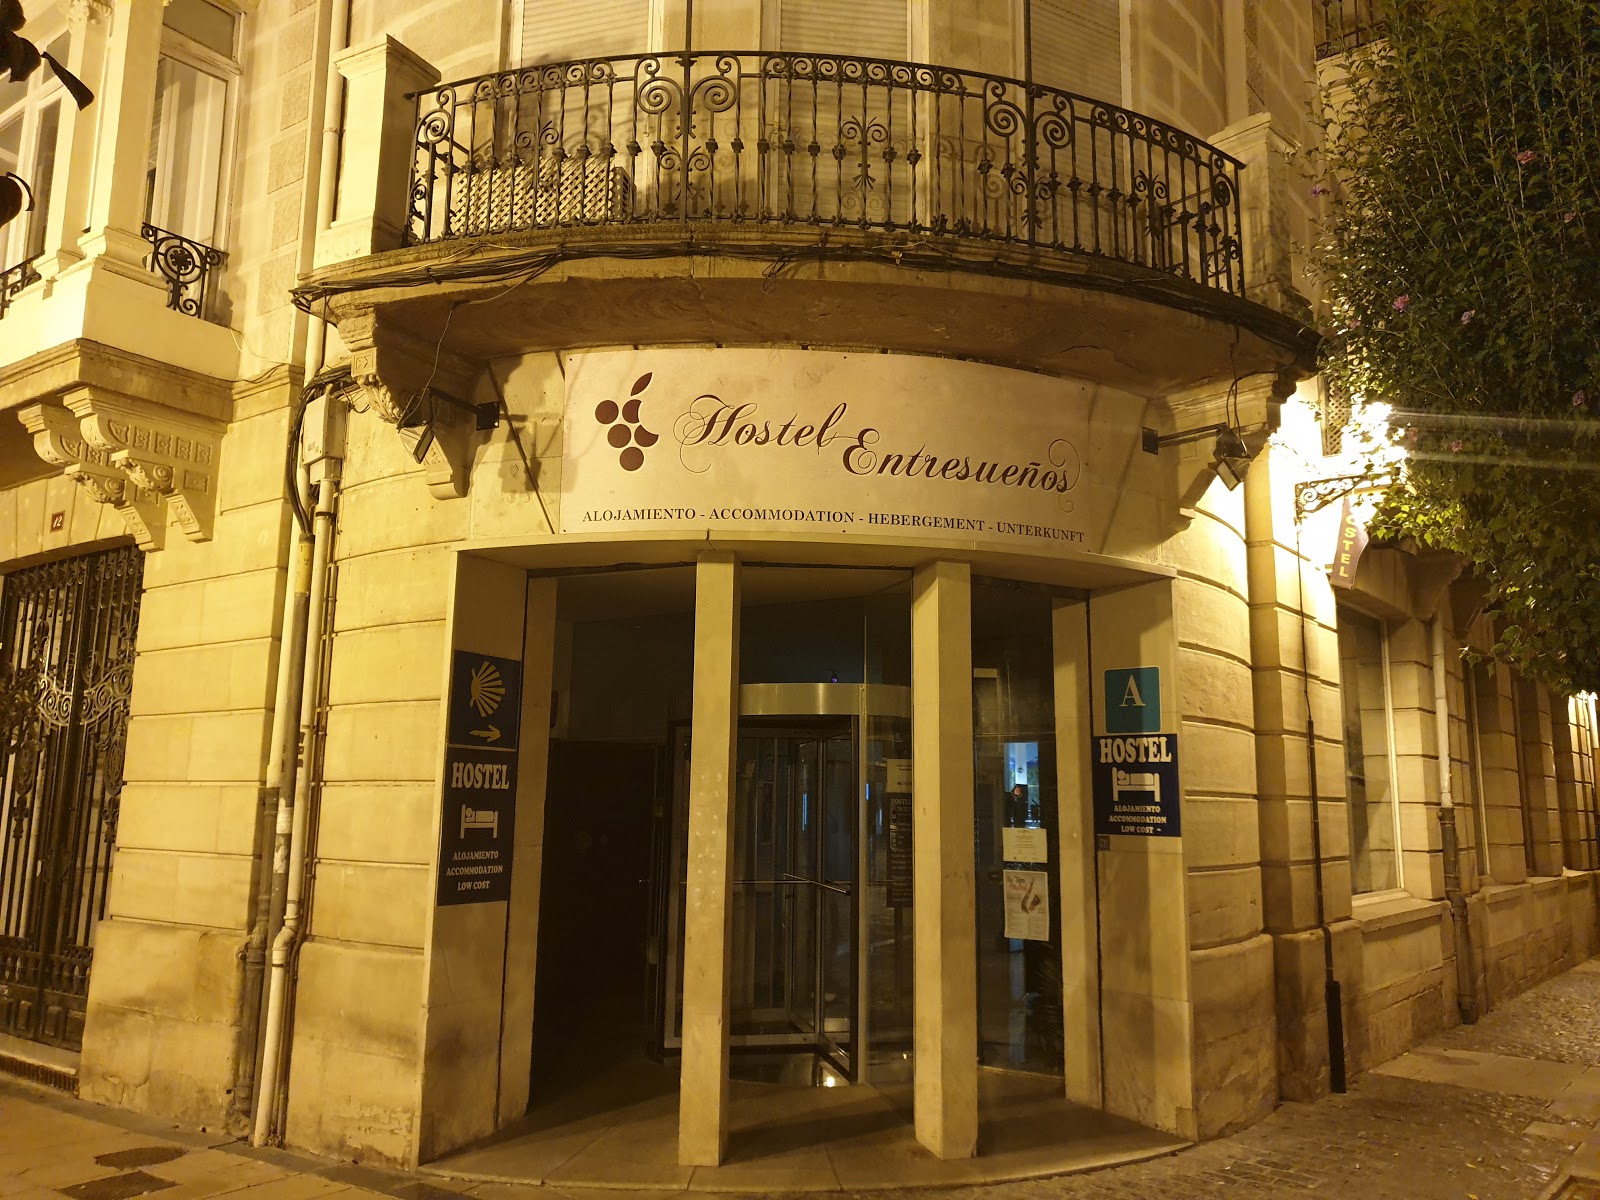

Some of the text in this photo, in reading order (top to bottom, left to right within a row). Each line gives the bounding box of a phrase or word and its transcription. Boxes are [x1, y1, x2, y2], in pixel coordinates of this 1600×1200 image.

[673, 394, 1080, 512] Hostel Entresueños
[582, 508, 696, 522] ALOJAMIENTO
[709, 508, 855, 523] ACCOMMODATION
[868, 513, 985, 531] HEBERGEMENT
[997, 521, 1085, 542] UNTERKUNFT
[1339, 514, 1358, 578] OSTEL
[1119, 674, 1146, 707] A
[1100, 737, 1172, 764] HOSTEL
[451, 761, 510, 790] HOSTEL
[1114, 804, 1161, 813] ALOJAMIENTO
[1108, 815, 1167, 824] ACCOMMODATION
[1121, 825, 1154, 834] LOW COST
[453, 850, 499, 861] ALOJAMIENTO
[446, 864, 504, 876] ACCOMMODATION
[457, 880, 491, 891] LOW COST
